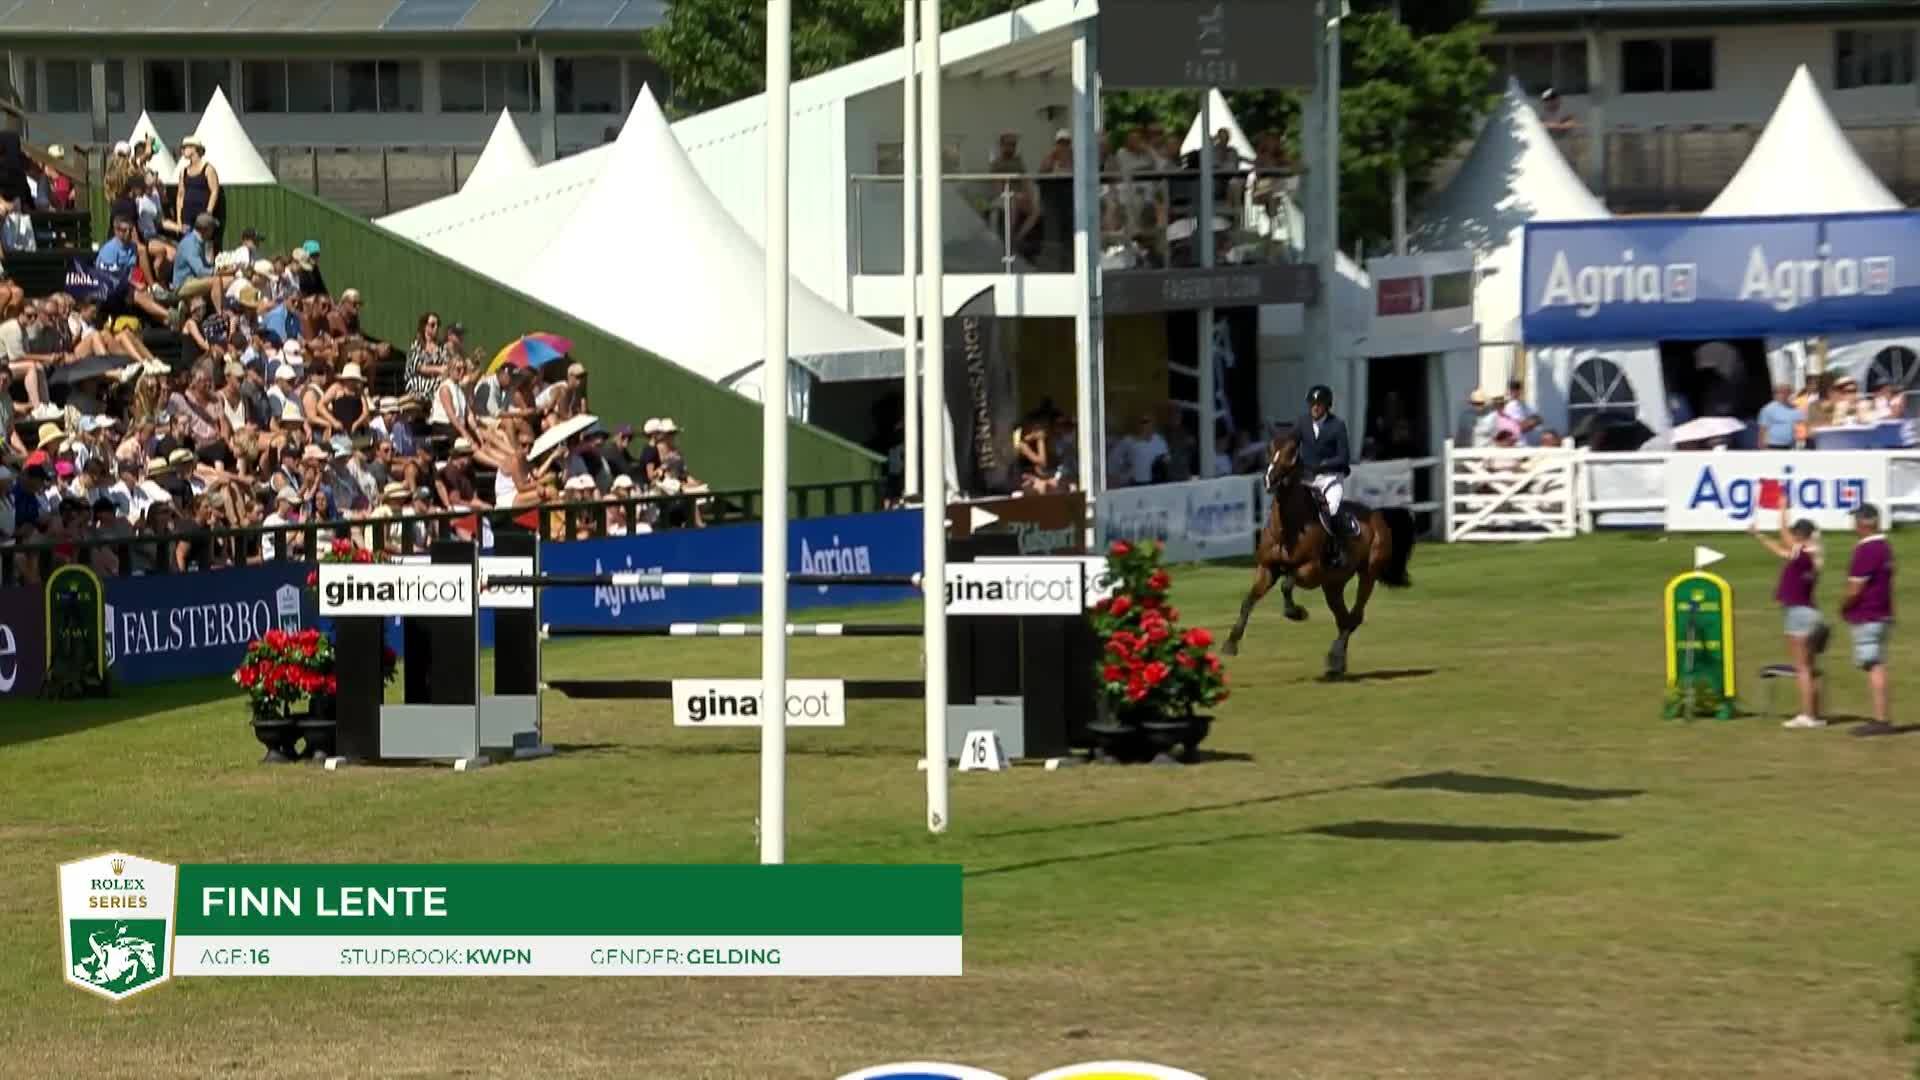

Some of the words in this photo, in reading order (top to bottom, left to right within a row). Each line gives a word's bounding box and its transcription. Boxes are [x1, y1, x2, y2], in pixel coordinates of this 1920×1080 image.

[1541, 249, 1661, 317] Agria
[1737, 244, 1858, 311] Agria
[1688, 465, 1825, 519] Agia
[325, 575, 465, 608] ginatricot
[801, 535, 855, 593] Agria
[122, 599, 271, 656] FALSTERBO
[971, 736, 987, 764] 16
